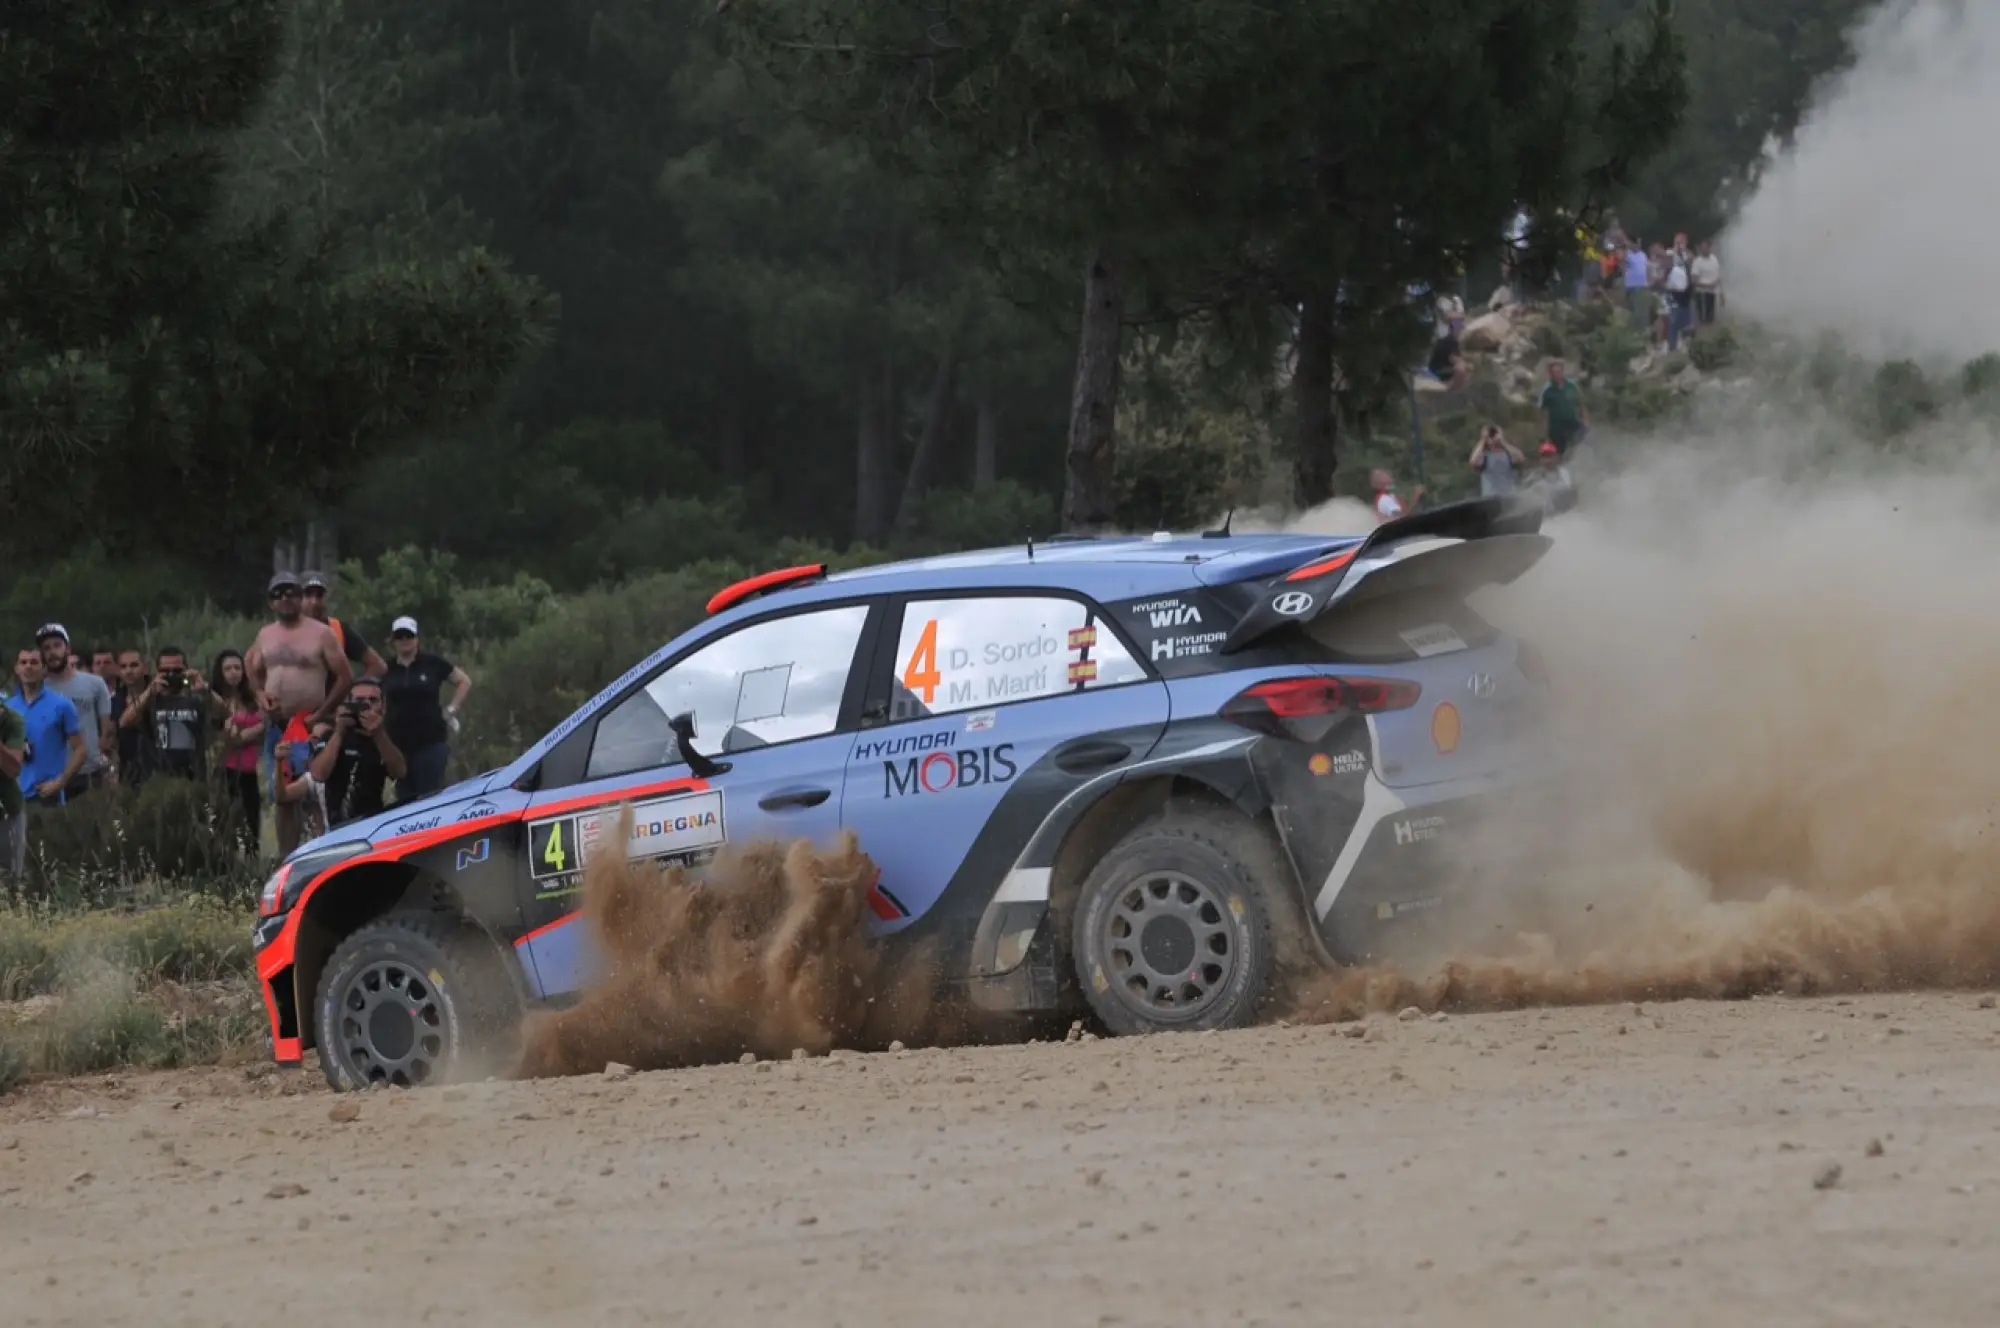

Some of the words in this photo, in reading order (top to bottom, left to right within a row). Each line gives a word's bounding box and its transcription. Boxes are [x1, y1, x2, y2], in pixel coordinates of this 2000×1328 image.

[1132, 598, 1179, 614] HYUNDAI
[1149, 604, 1202, 629] WIA
[951, 648, 975, 671] D.
[983, 636, 1058, 666] Sordo
[1175, 631, 1228, 648] HYUNDAI
[1175, 644, 1212, 658] STEEL
[903, 619, 942, 704] 4
[950, 680, 978, 704] M.
[987, 665, 1048, 699] Martí
[855, 730, 957, 760] HYUNDAI
[882, 743, 1018, 799] MOBIS
[630, 811, 717, 840] RDEGNA
[544, 820, 566, 872] 4
